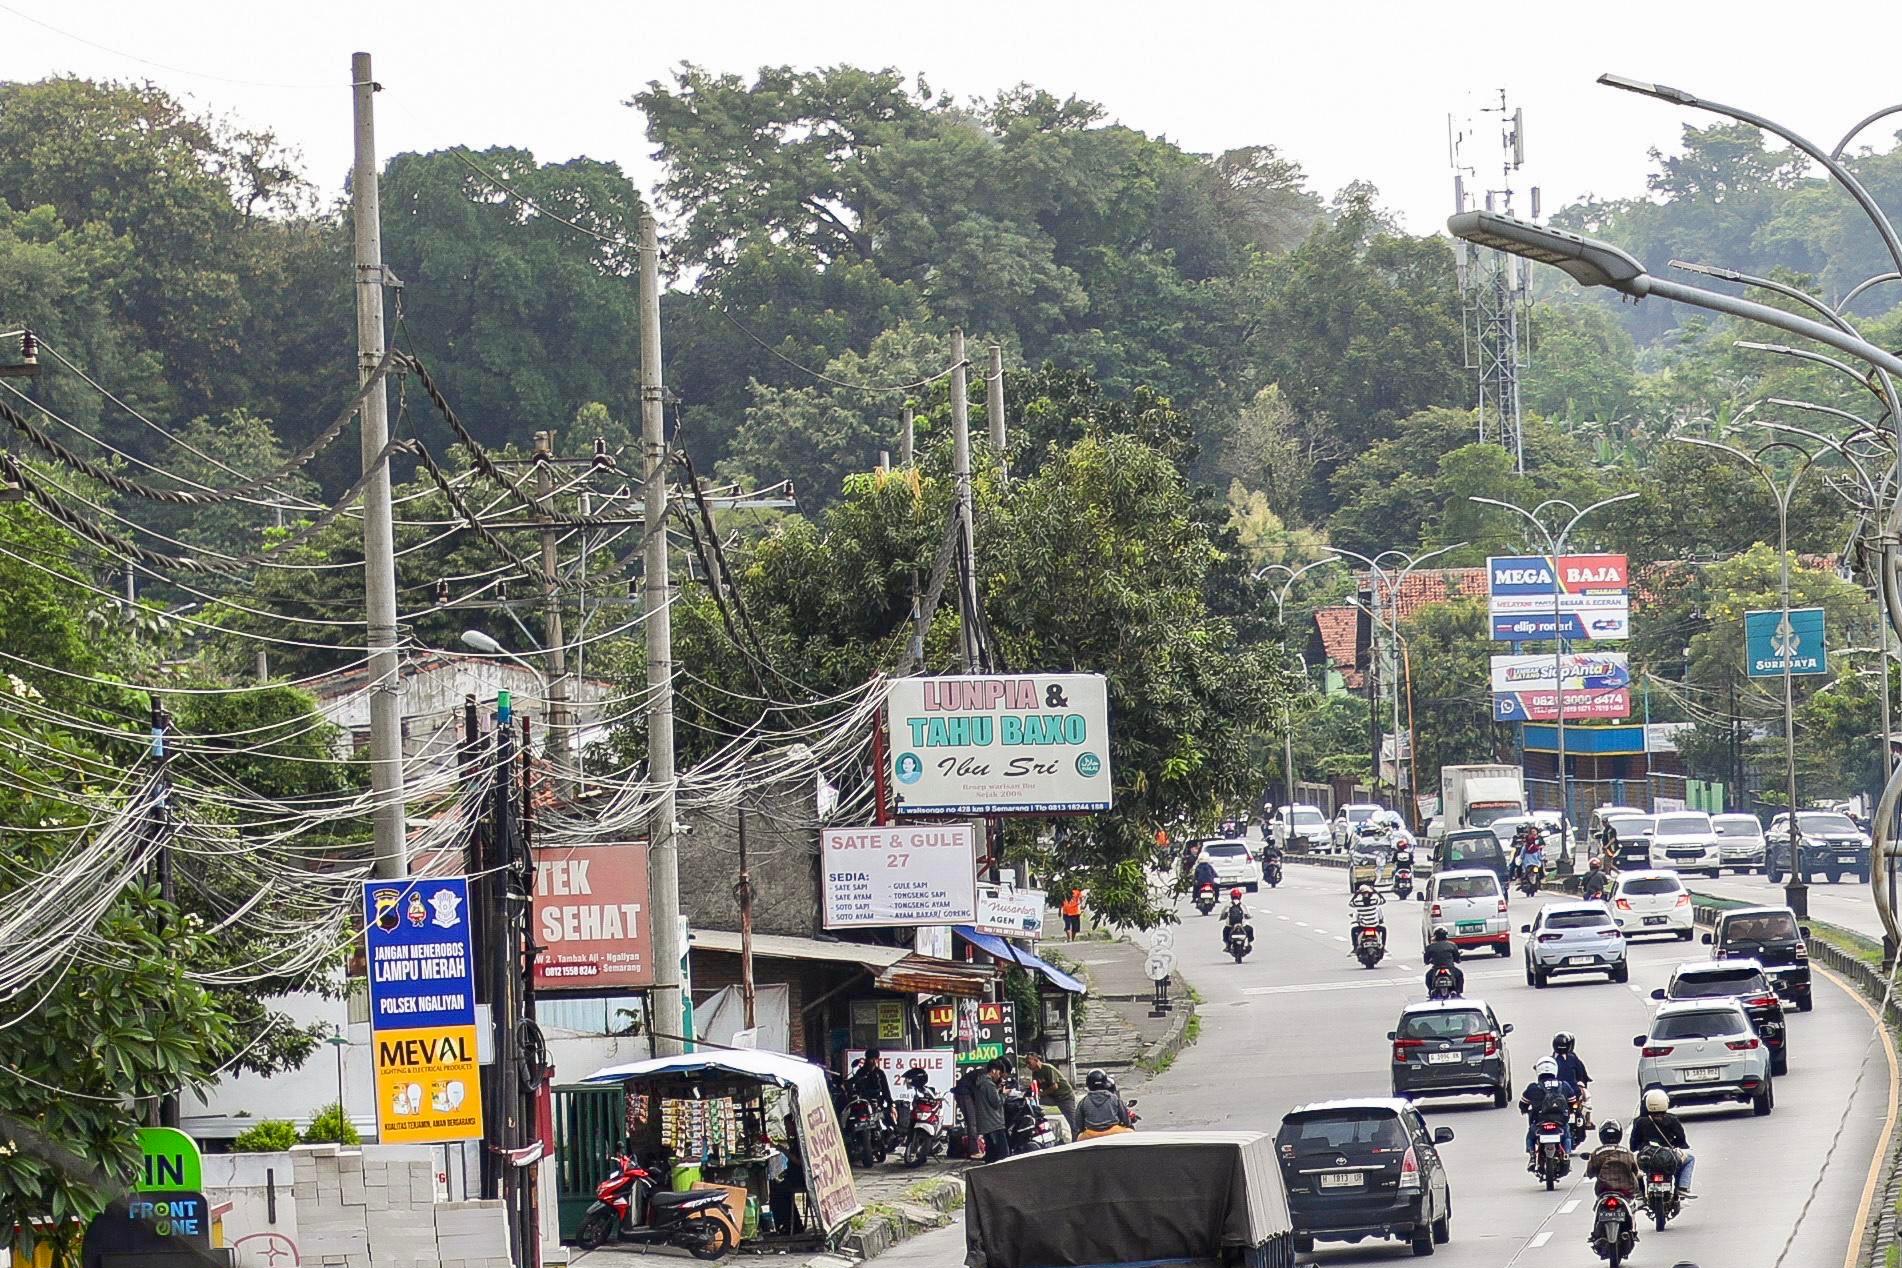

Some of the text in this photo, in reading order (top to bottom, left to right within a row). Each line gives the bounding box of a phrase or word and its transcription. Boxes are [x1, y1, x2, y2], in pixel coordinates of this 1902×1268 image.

[1495, 568, 1620, 584] MEGA BAJA
[924, 680, 1068, 711] LUNPIA &
[907, 714, 1087, 748] TAHU BAXO
[938, 756, 1058, 776] Ibu Sri
[832, 833, 963, 849] SATE & GULE
[887, 854, 910, 868] 27
[829, 873, 870, 881] SEDIA:
[542, 904, 640, 942] SEHAT
[990, 916, 1014, 924] AGEN
[375, 942, 464, 960] JANGAN MENEROBOS
[558, 953, 586, 963] Tambak
[606, 953, 639, 962] Ngaliyan
[375, 957, 465, 982] LAMPU MERAH
[603, 964, 641, 973] Semarang
[380, 994, 464, 1014] POLSEK NGALIYAN
[381, 1037, 472, 1067] MEVAL
[859, 1058, 943, 1070] STE & GULE
[129, 1201, 197, 1219] FRONT
[156, 1220, 198, 1236] ONE
